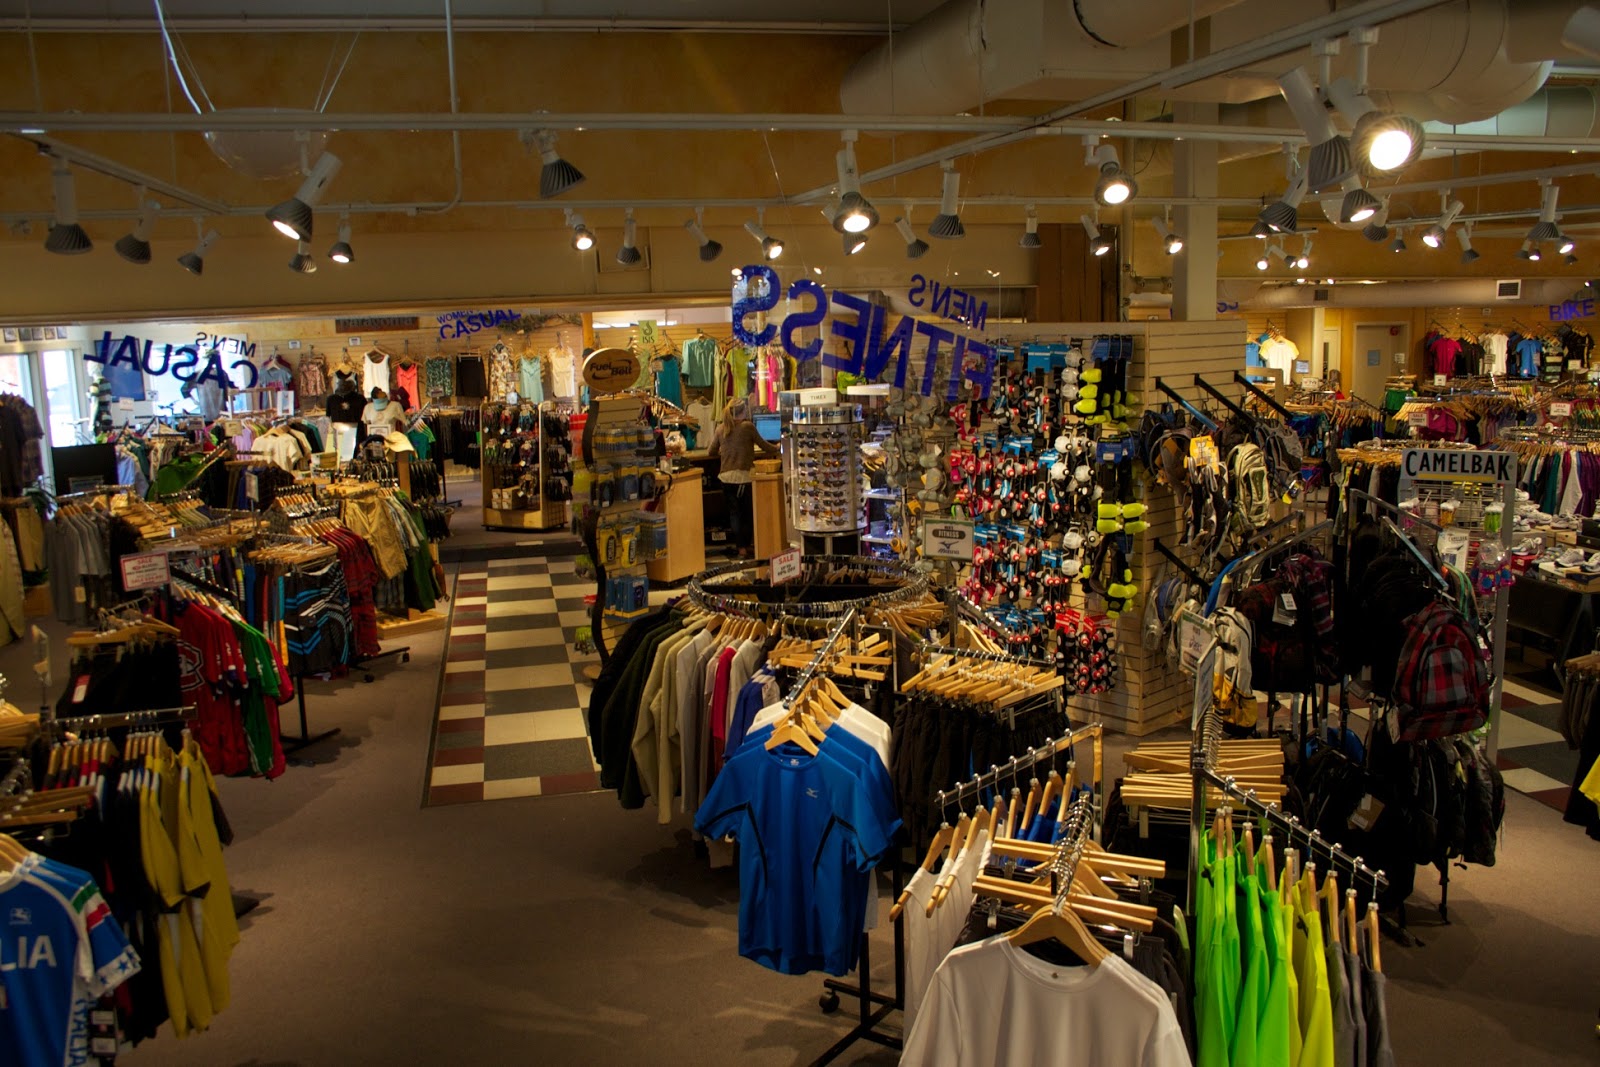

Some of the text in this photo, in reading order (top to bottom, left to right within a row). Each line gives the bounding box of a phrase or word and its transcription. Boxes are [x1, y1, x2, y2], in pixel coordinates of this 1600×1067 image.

[1549, 298, 1596, 321] BIKE
[440, 309, 522, 339] CASUAL
[642, 336, 655, 344] ISIS
[1405, 451, 1510, 481] CAMELBAK
[938, 530, 960, 539] FITNESS
[778, 554, 794, 565] SALE
